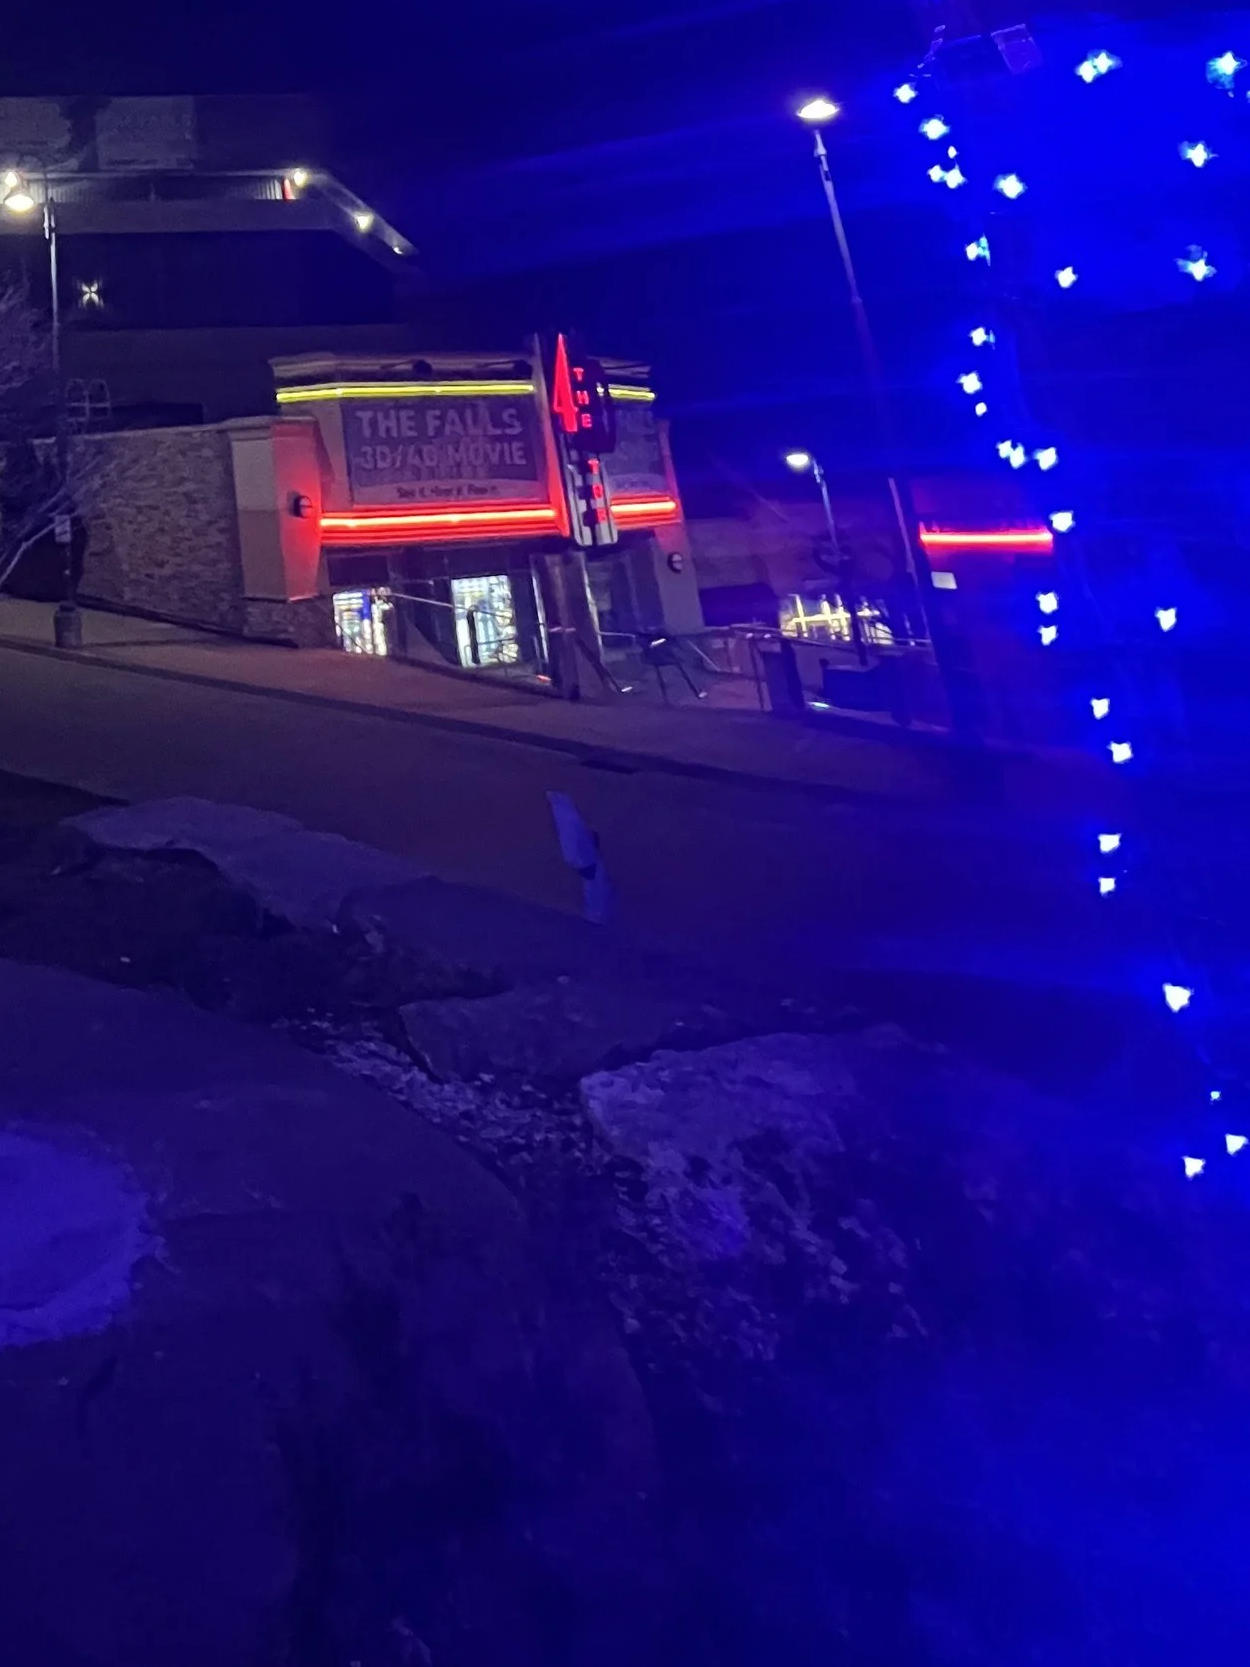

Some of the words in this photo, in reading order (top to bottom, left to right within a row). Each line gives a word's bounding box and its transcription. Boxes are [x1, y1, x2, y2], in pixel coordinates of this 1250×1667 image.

[354, 408, 419, 439] THE
[424, 405, 524, 438] FALLS
[445, 440, 528, 467] MOVIE
